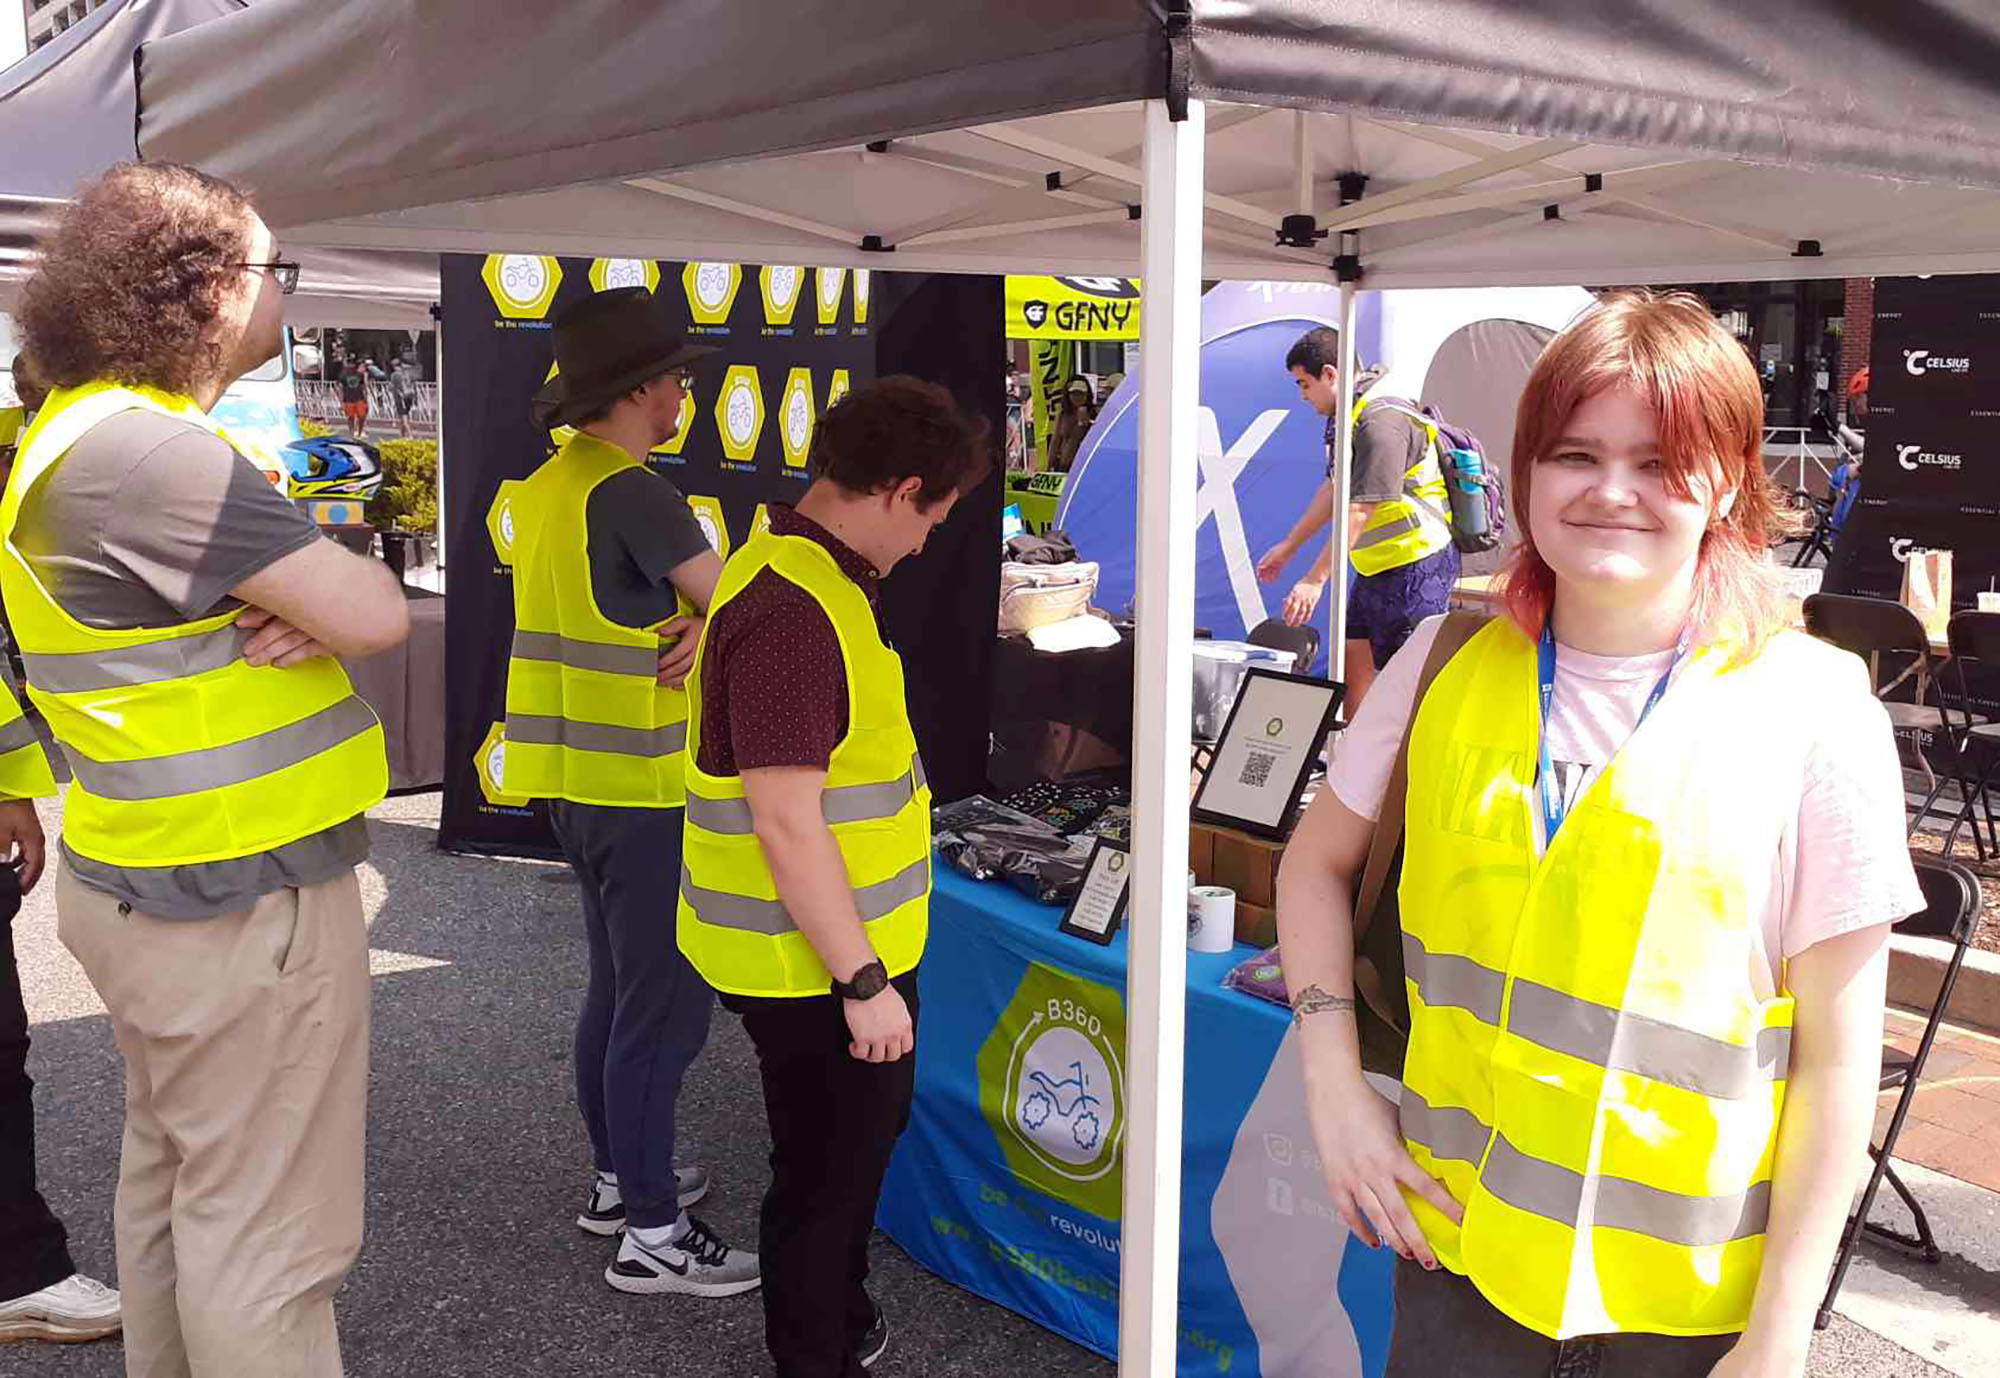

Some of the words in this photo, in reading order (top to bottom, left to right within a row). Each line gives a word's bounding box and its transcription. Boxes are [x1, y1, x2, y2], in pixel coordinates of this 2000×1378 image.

[1055, 300, 1132, 331] GFNY
[1926, 357, 1970, 369] CELSIUS
[1918, 453, 1961, 465] CELSIUS
[1031, 473, 1062, 491] GFNY
[1047, 998, 1101, 1036] B360
